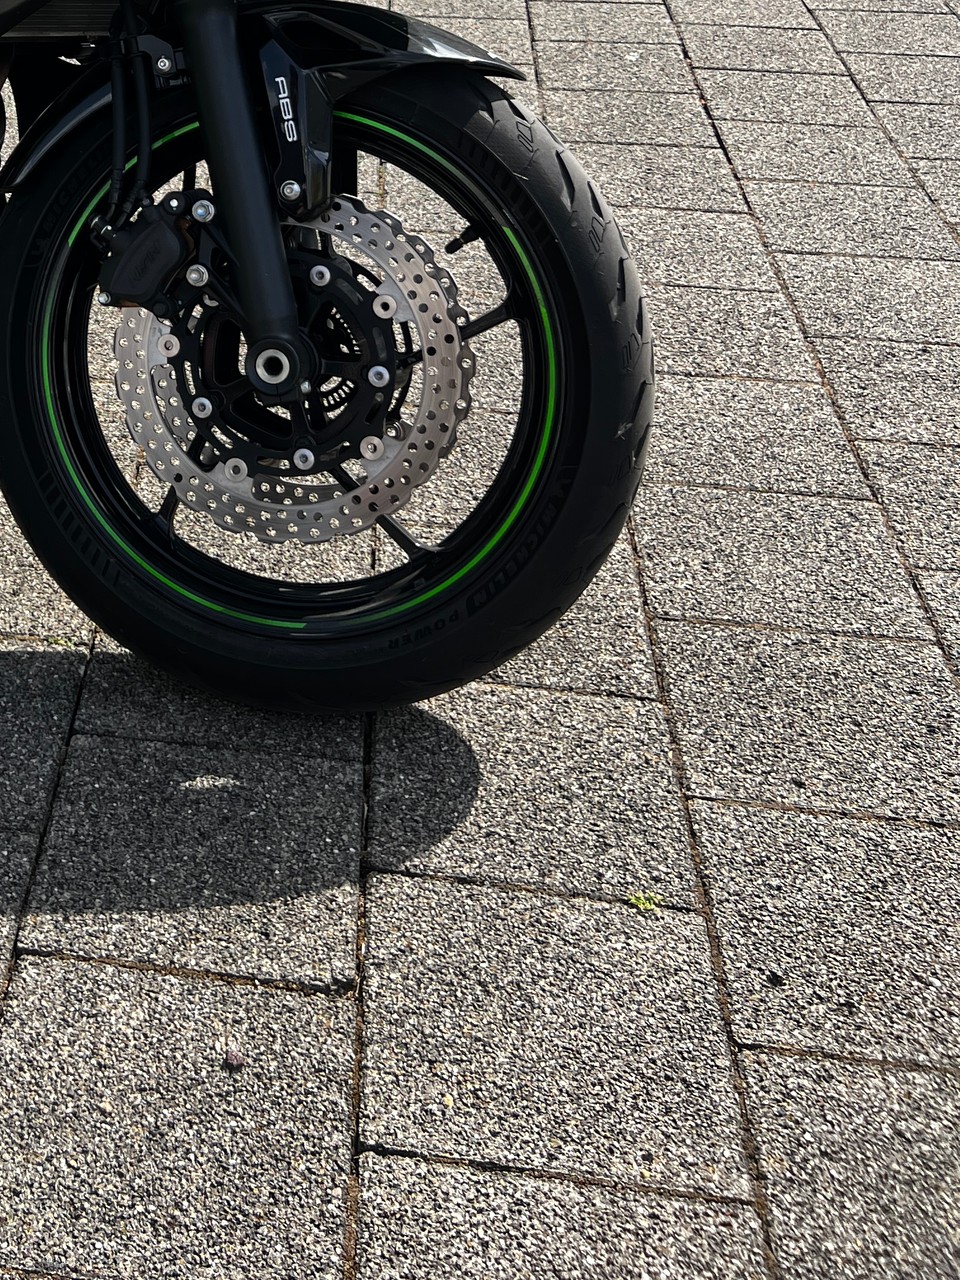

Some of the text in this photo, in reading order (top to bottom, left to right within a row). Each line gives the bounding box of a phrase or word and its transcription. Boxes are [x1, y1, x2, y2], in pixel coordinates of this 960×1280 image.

[274, 76, 298, 142] ABS
[387, 501, 557, 650] MICHELIN POWER
